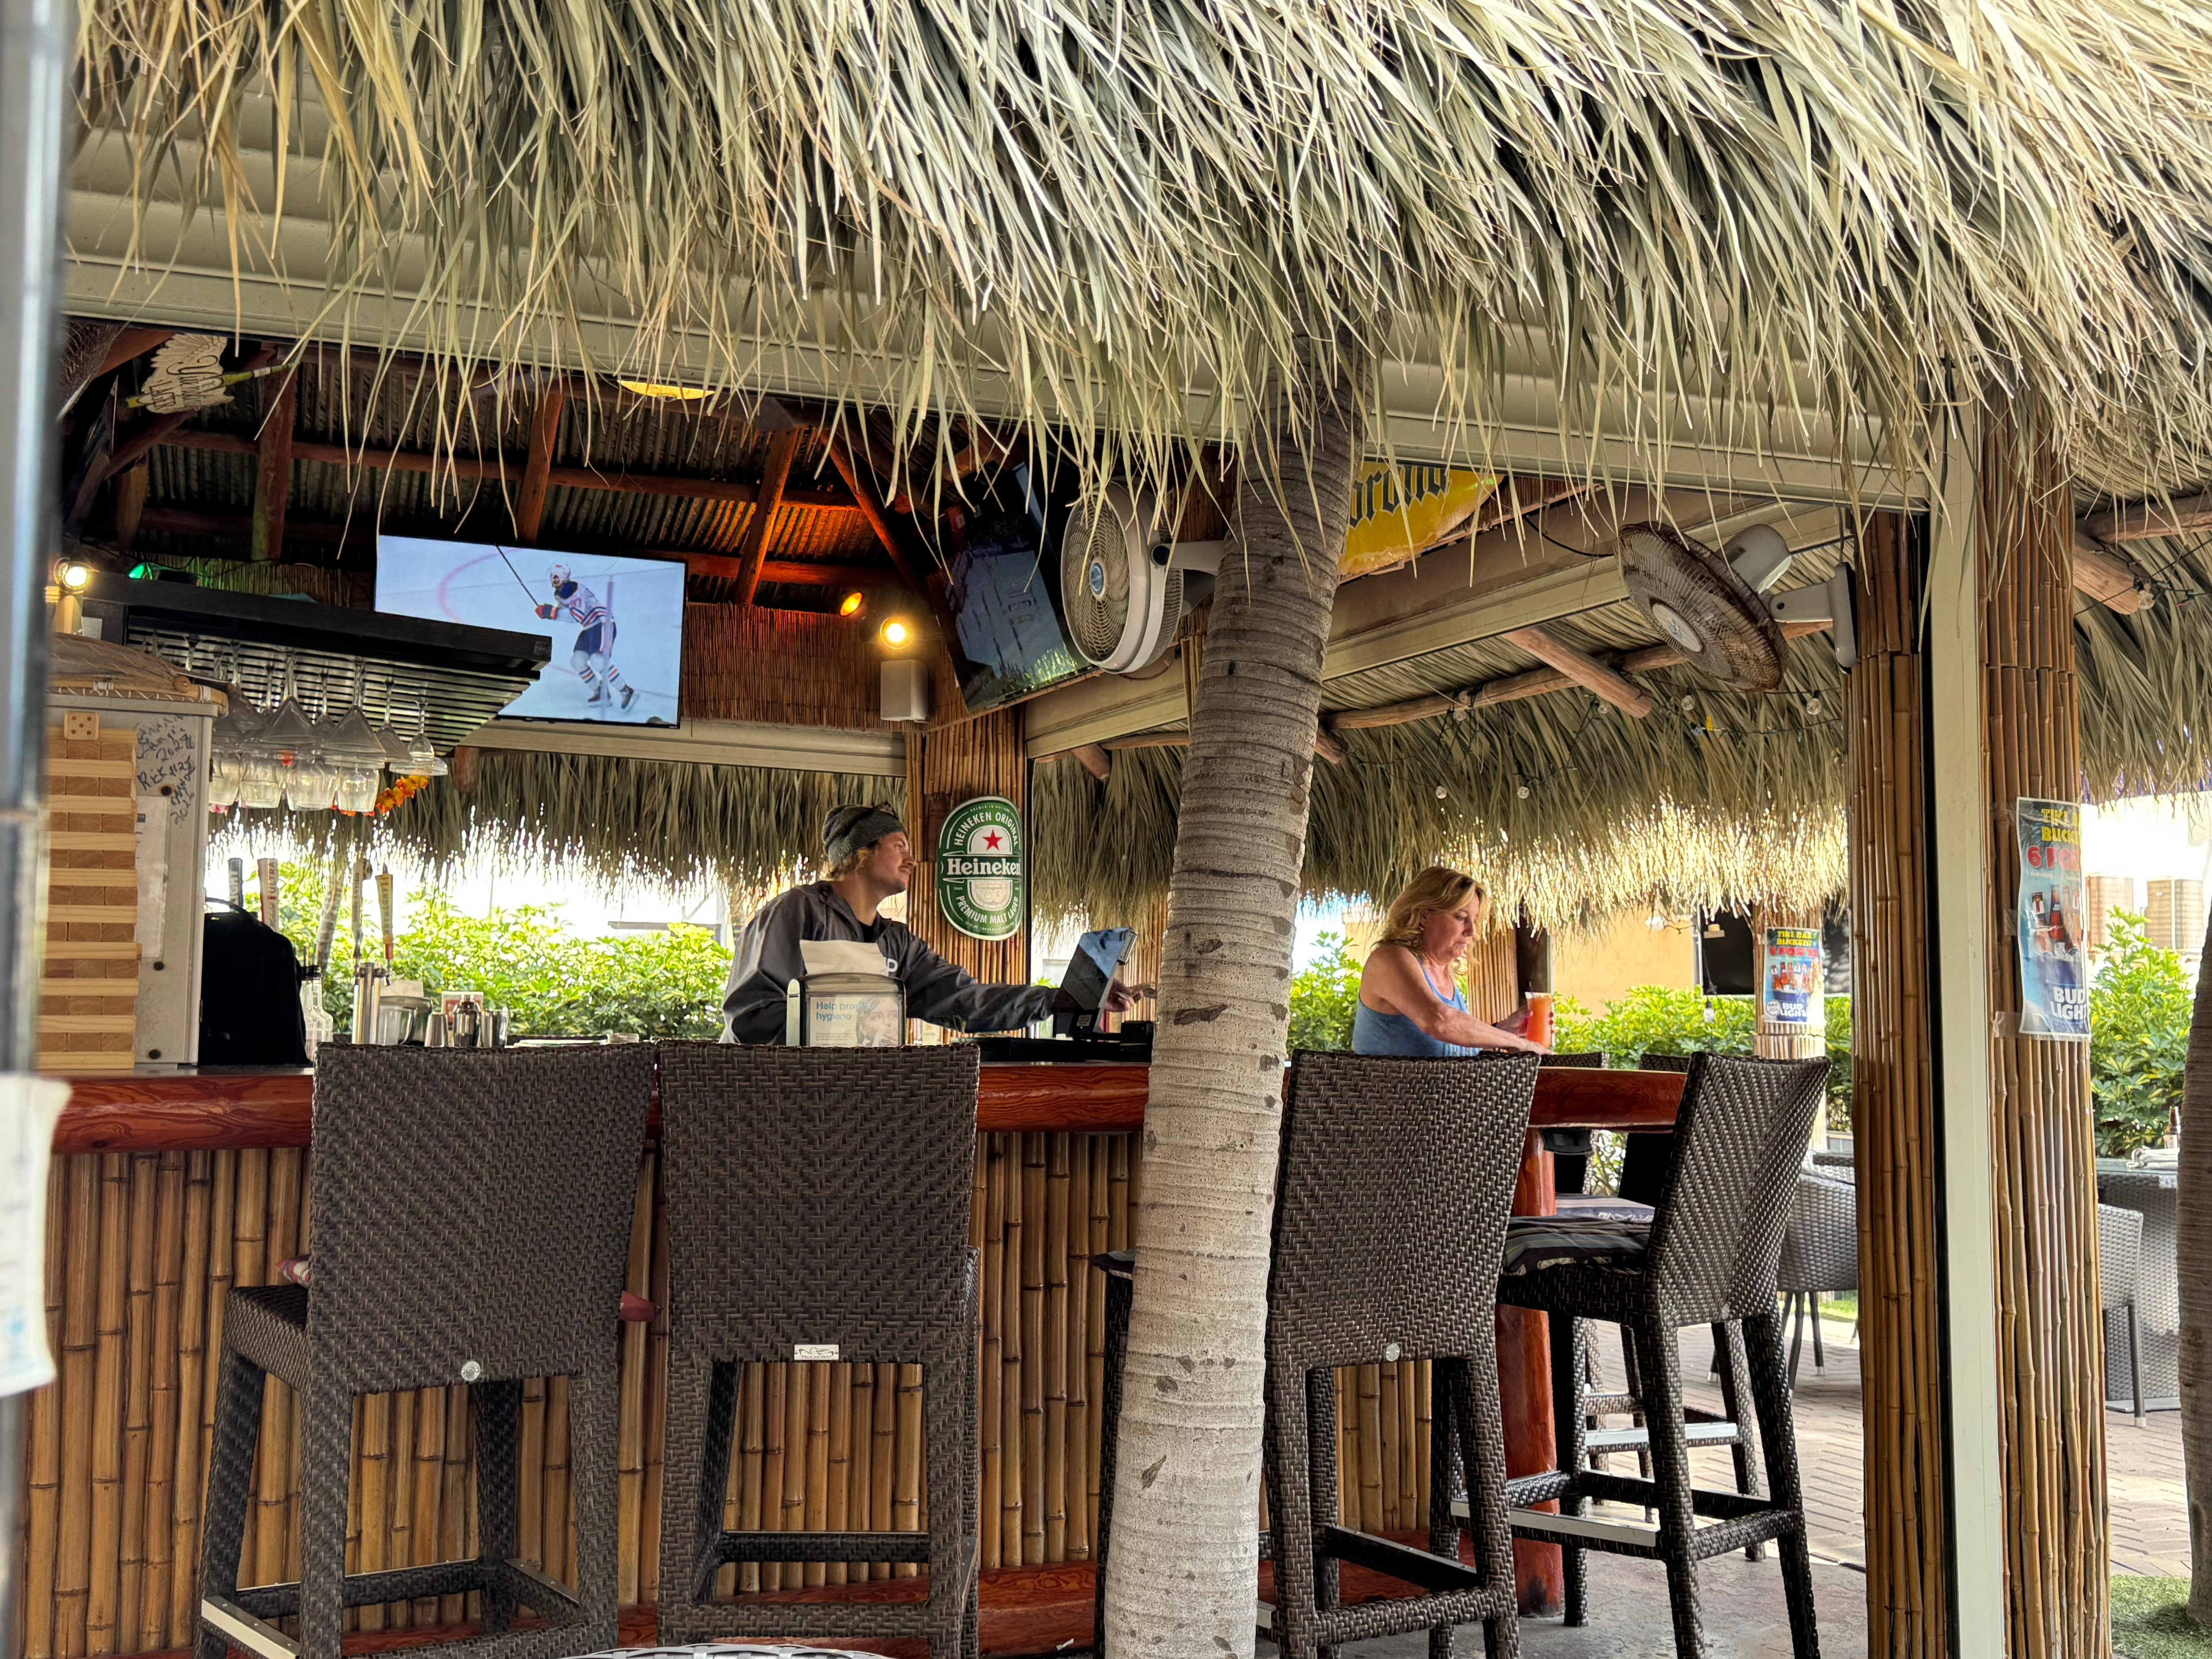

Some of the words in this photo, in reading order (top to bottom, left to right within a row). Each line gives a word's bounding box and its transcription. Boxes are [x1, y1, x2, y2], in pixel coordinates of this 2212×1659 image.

[149, 380, 176, 411] LAGER
[1350, 466, 1448, 528] orona
[2041, 809, 2068, 825] TIKI
[954, 811, 992, 846] HEINEKEN
[995, 812, 1019, 847] ORIGINAL
[2042, 827, 2079, 845] BUCKE
[2027, 845, 2042, 868] 6
[947, 858, 1022, 876] Heineken
[956, 895, 987, 924] PREMIUM
[990, 913, 1007, 924] MALT
[1007, 896, 1019, 920] LAGER
[2053, 986, 2086, 1004] BUD
[816, 1002, 837, 1011] Help
[1782, 1002, 1804, 1010] BUD
[816, 1012, 852, 1022] hygiene
